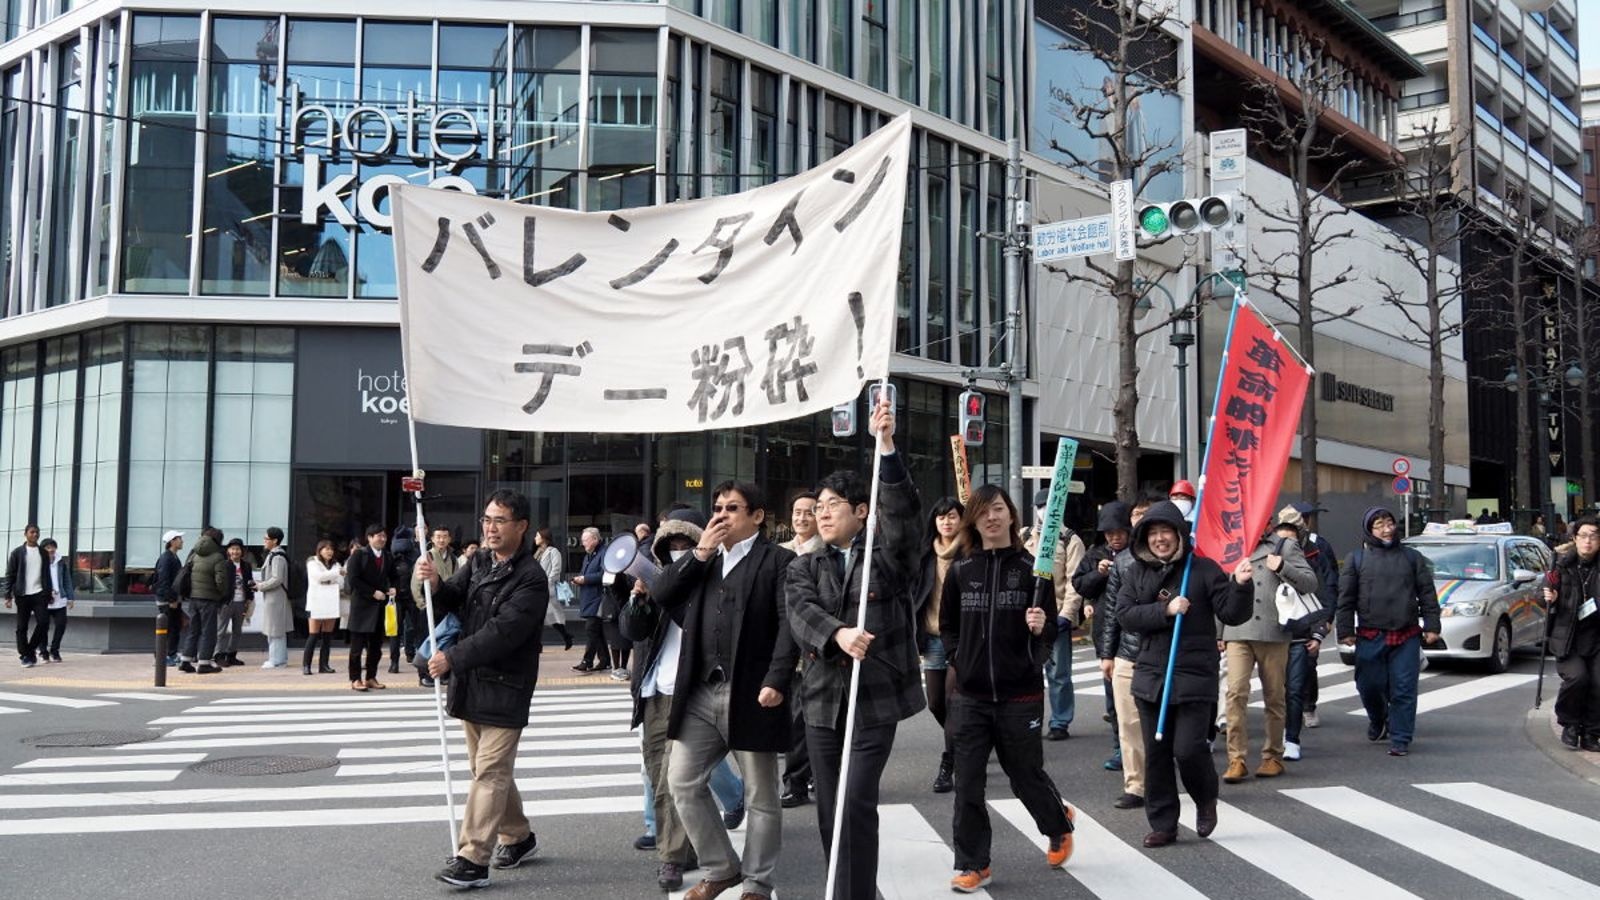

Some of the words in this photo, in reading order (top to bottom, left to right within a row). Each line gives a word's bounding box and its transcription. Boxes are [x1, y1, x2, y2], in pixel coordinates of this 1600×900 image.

[290, 82, 496, 162] hotel
[420, 155, 892, 290] バレンタイン
[1057, 246, 1068, 255] and
